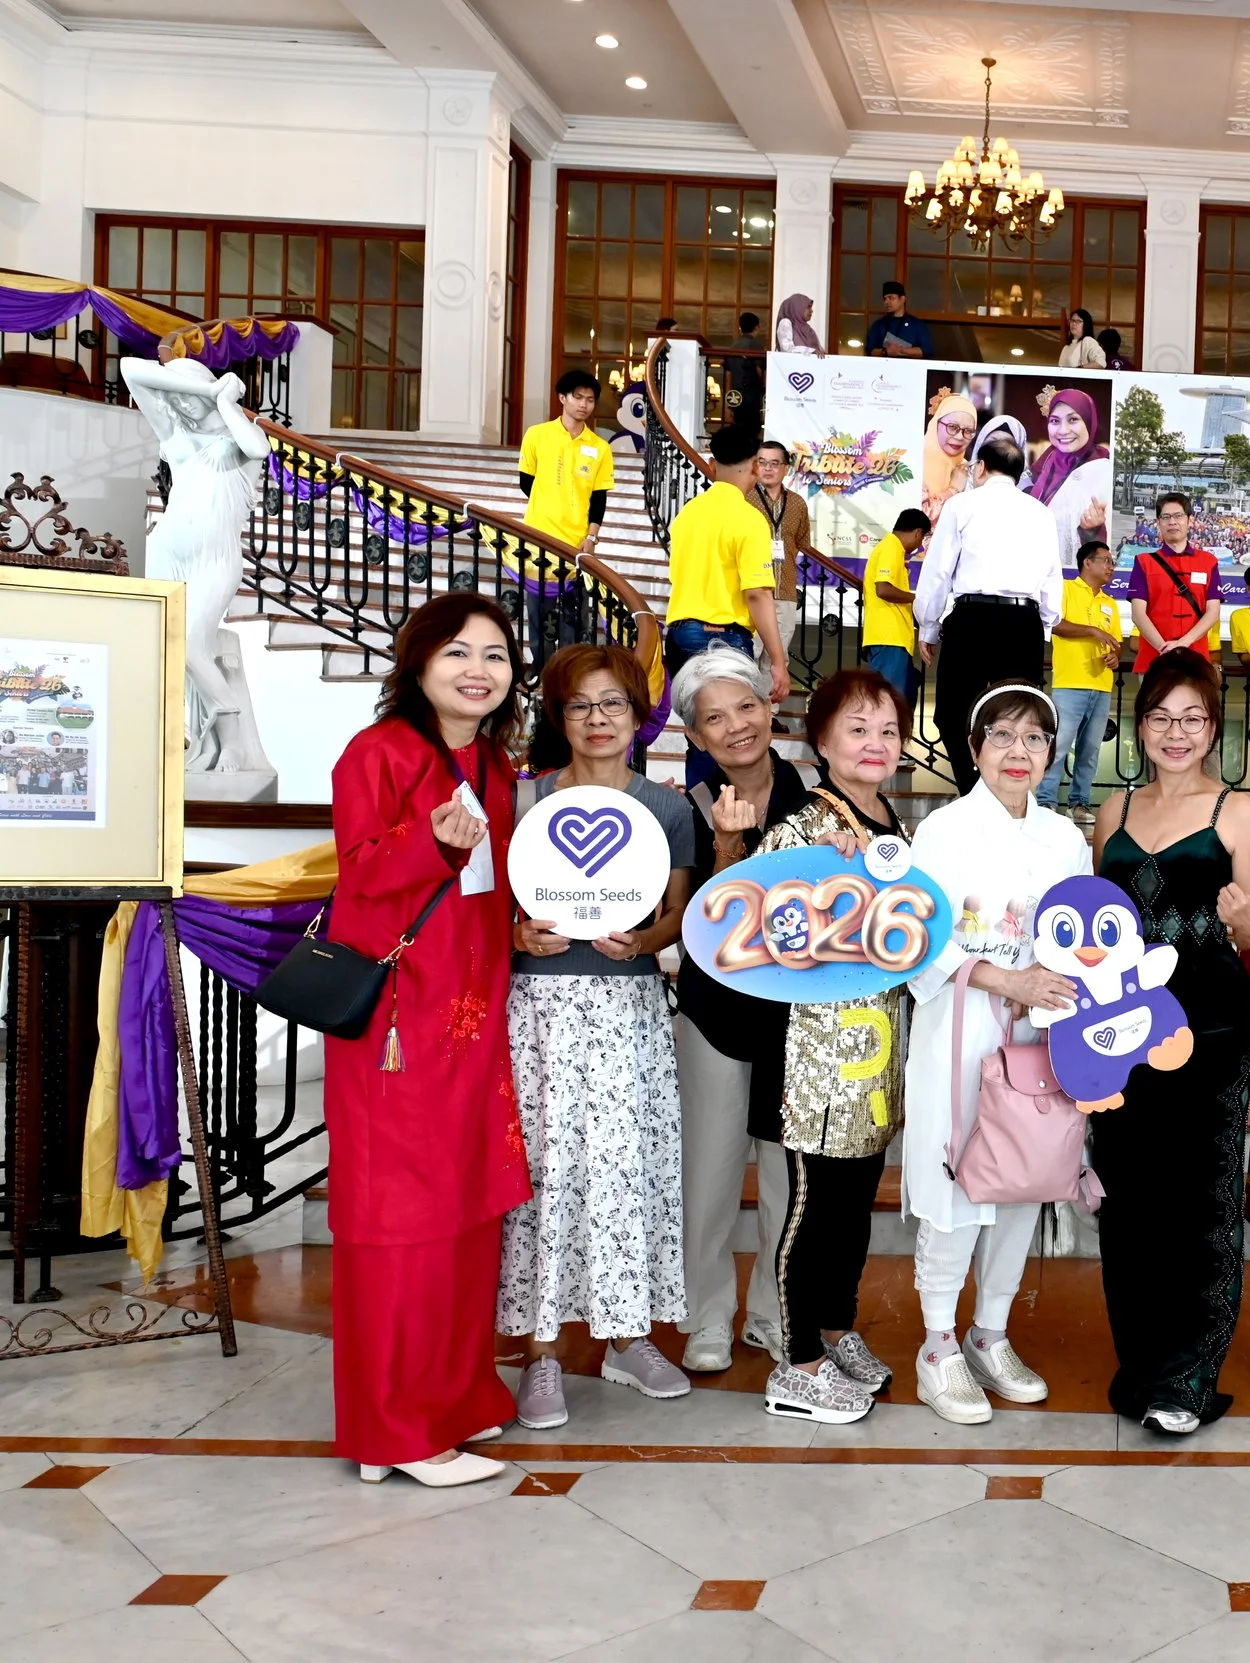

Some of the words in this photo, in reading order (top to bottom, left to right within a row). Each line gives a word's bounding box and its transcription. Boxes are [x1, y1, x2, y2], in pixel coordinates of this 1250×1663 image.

[821, 443, 862, 456] Blossom
[791, 450, 866, 475] Tribute
[867, 457, 898, 476] 26
[802, 476, 811, 485] to
[816, 474, 852, 486] Seniors
[1109, 578, 1130, 589] Ser
[1221, 583, 1245, 595] Care
[40, 679, 62, 691] 26
[535, 887, 596, 901] Blossom
[600, 888, 642, 901] Seeds
[574, 906, 602, 920] 福善
[703, 873, 936, 972] 2026
